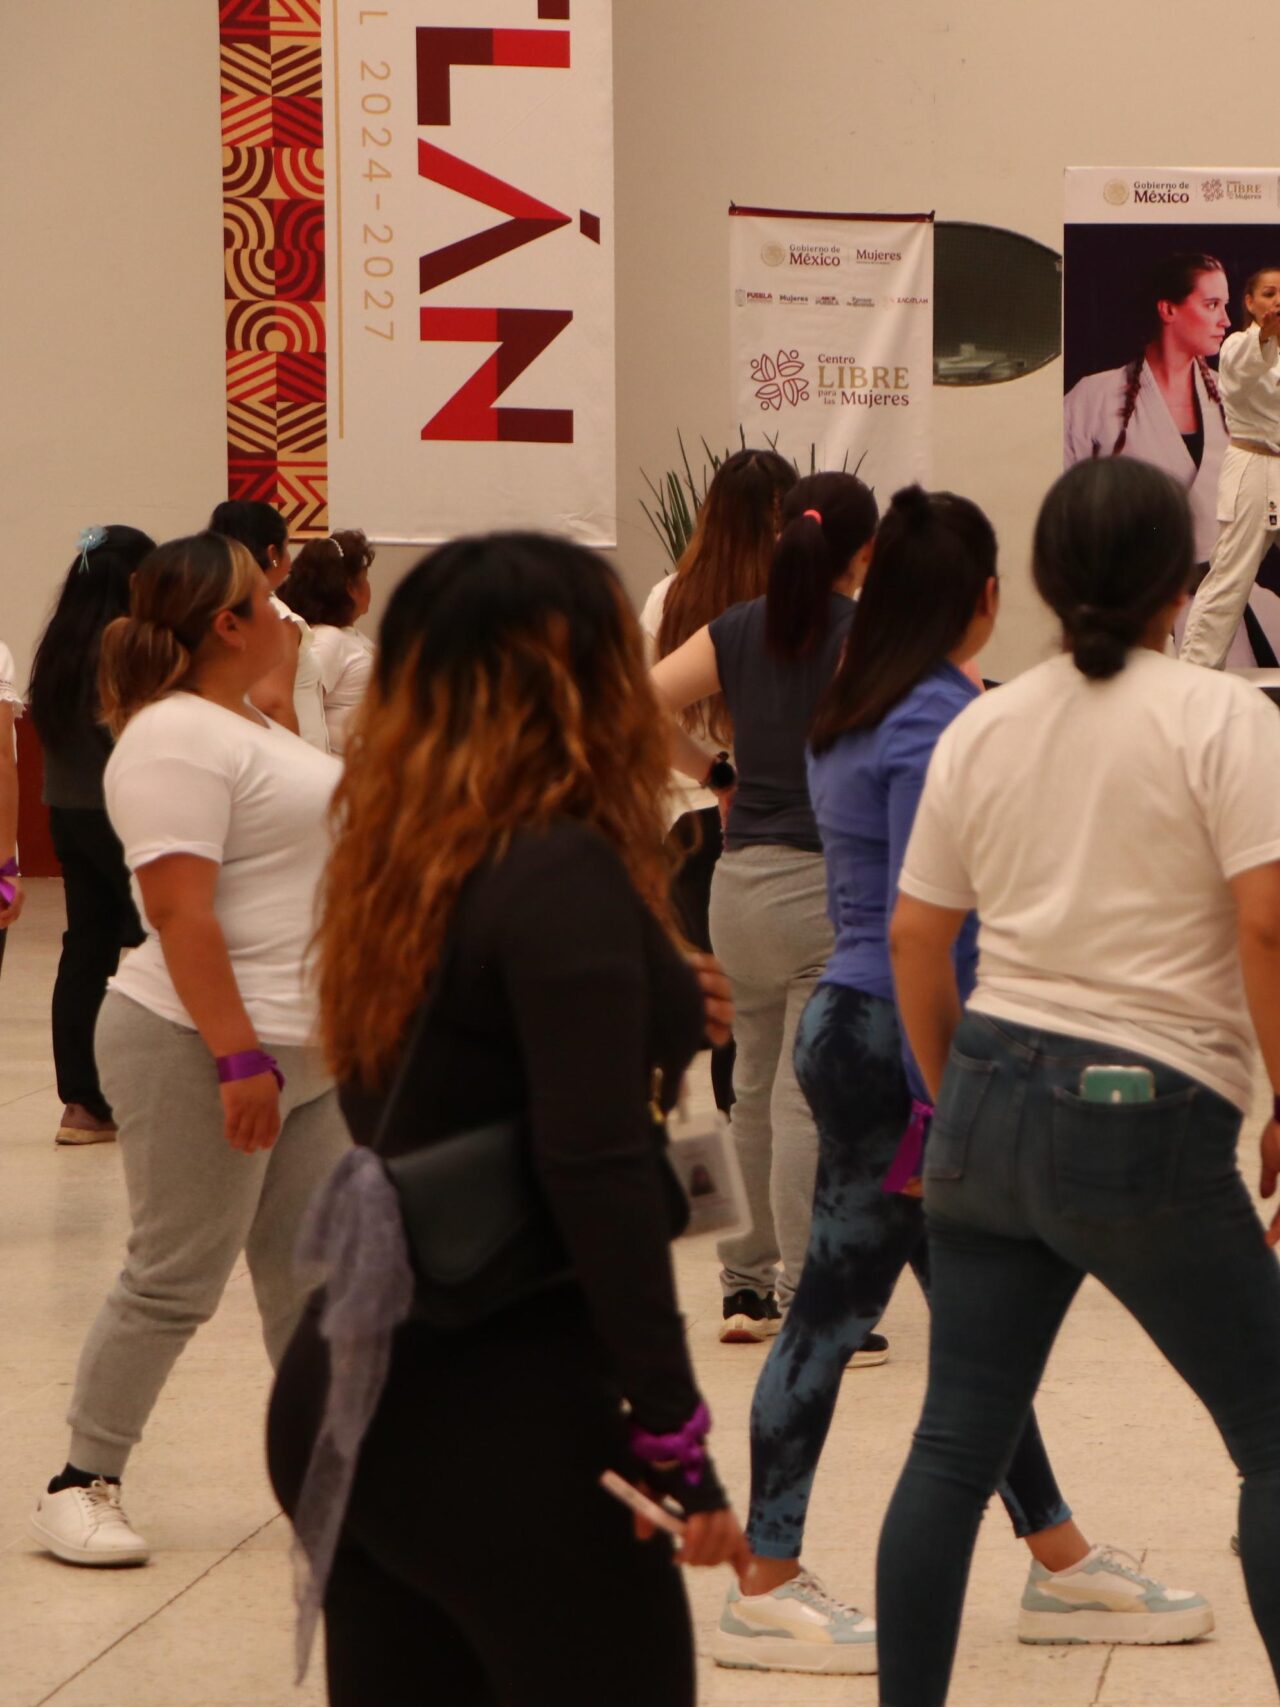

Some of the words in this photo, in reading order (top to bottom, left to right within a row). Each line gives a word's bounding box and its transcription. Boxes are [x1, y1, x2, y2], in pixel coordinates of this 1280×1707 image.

[1133, 180, 1176, 190] Gobierno
[1179, 180, 1190, 190] de
[1226, 183, 1262, 193] LIBRE
[359, 60, 395, 343] 2024-2027
[1133, 189, 1190, 204] México
[416, 0, 601, 444] LÁN
[789, 244, 829, 253] Gobierno
[830, 245, 841, 253] de
[856, 249, 902, 262] Mujeres
[789, 251, 841, 267] México
[817, 353, 856, 365] Centro
[817, 366, 910, 390] LIBRE
[840, 390, 910, 409] Mujeres
